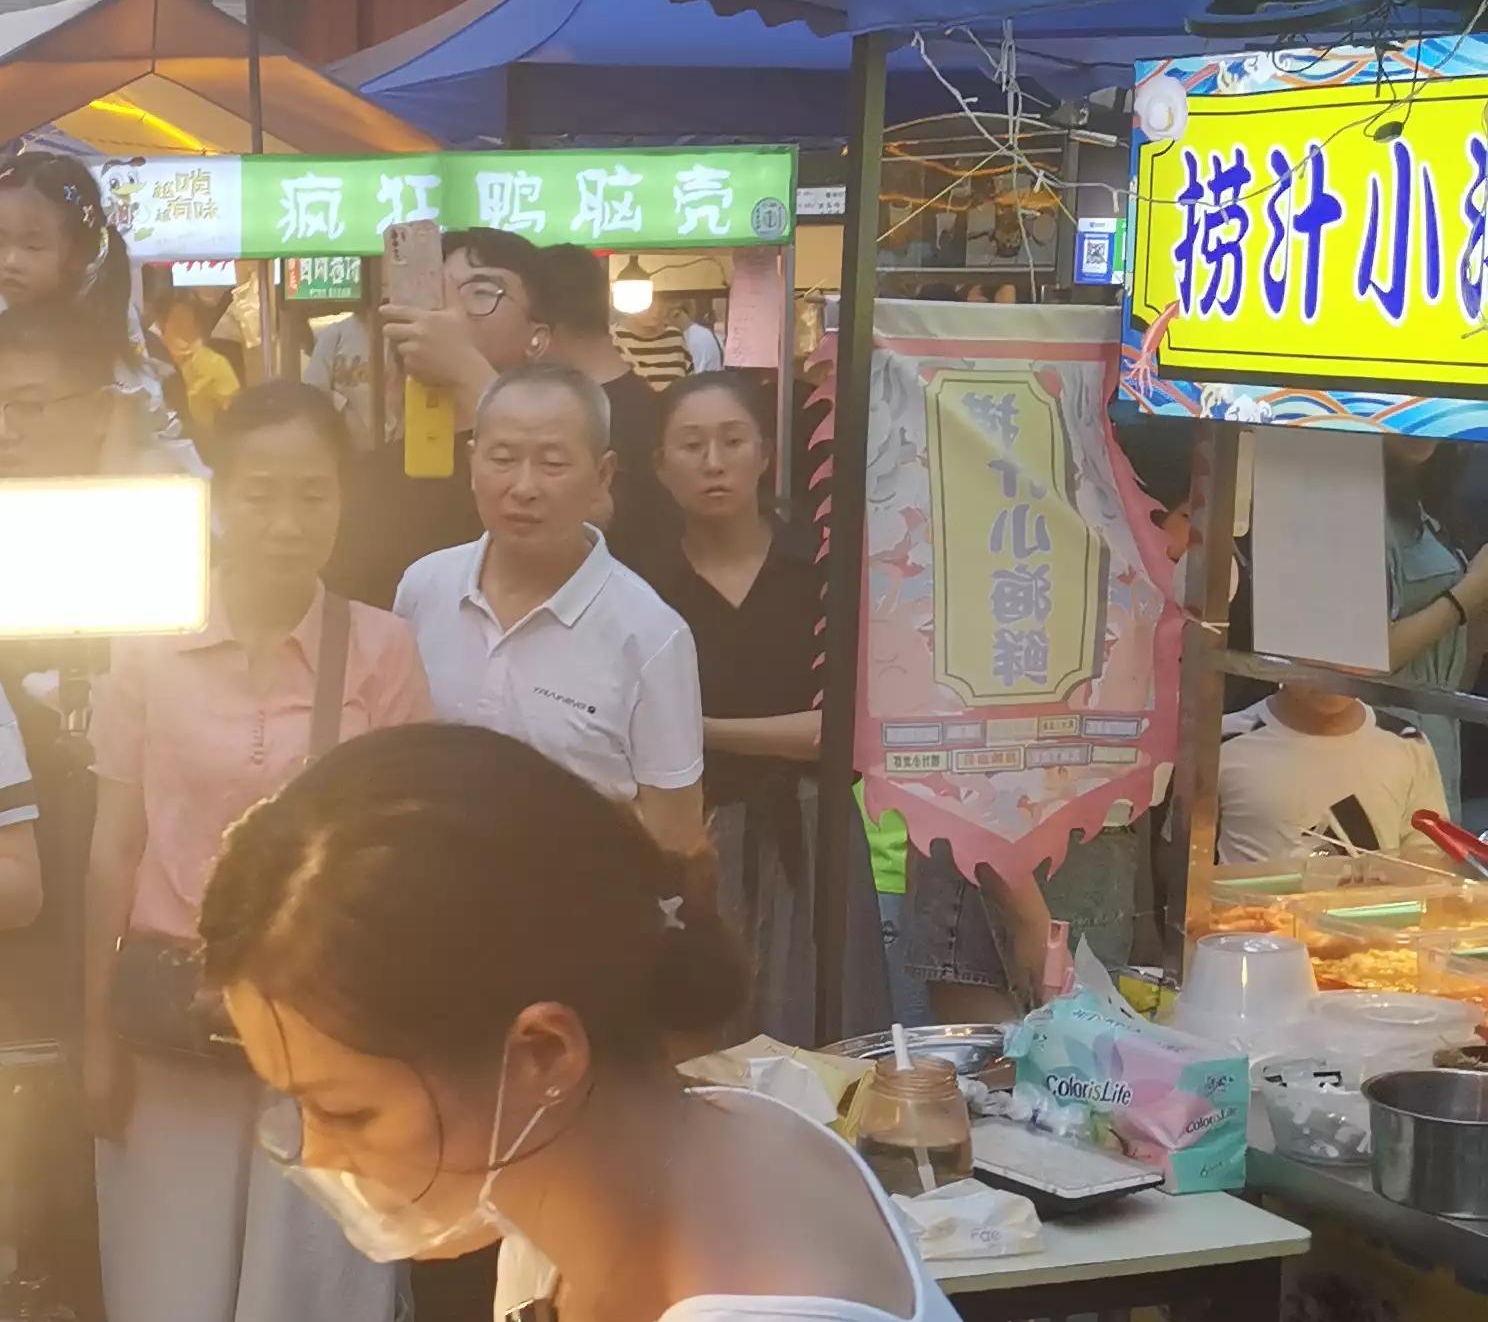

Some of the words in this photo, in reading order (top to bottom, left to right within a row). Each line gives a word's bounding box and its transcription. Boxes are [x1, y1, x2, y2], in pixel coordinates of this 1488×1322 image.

[278, 165, 733, 239] 疯狂鸭脑壳
[1173, 140, 1488, 321] 捞汁小
[1046, 1073, 1132, 1107] ColorisLife
